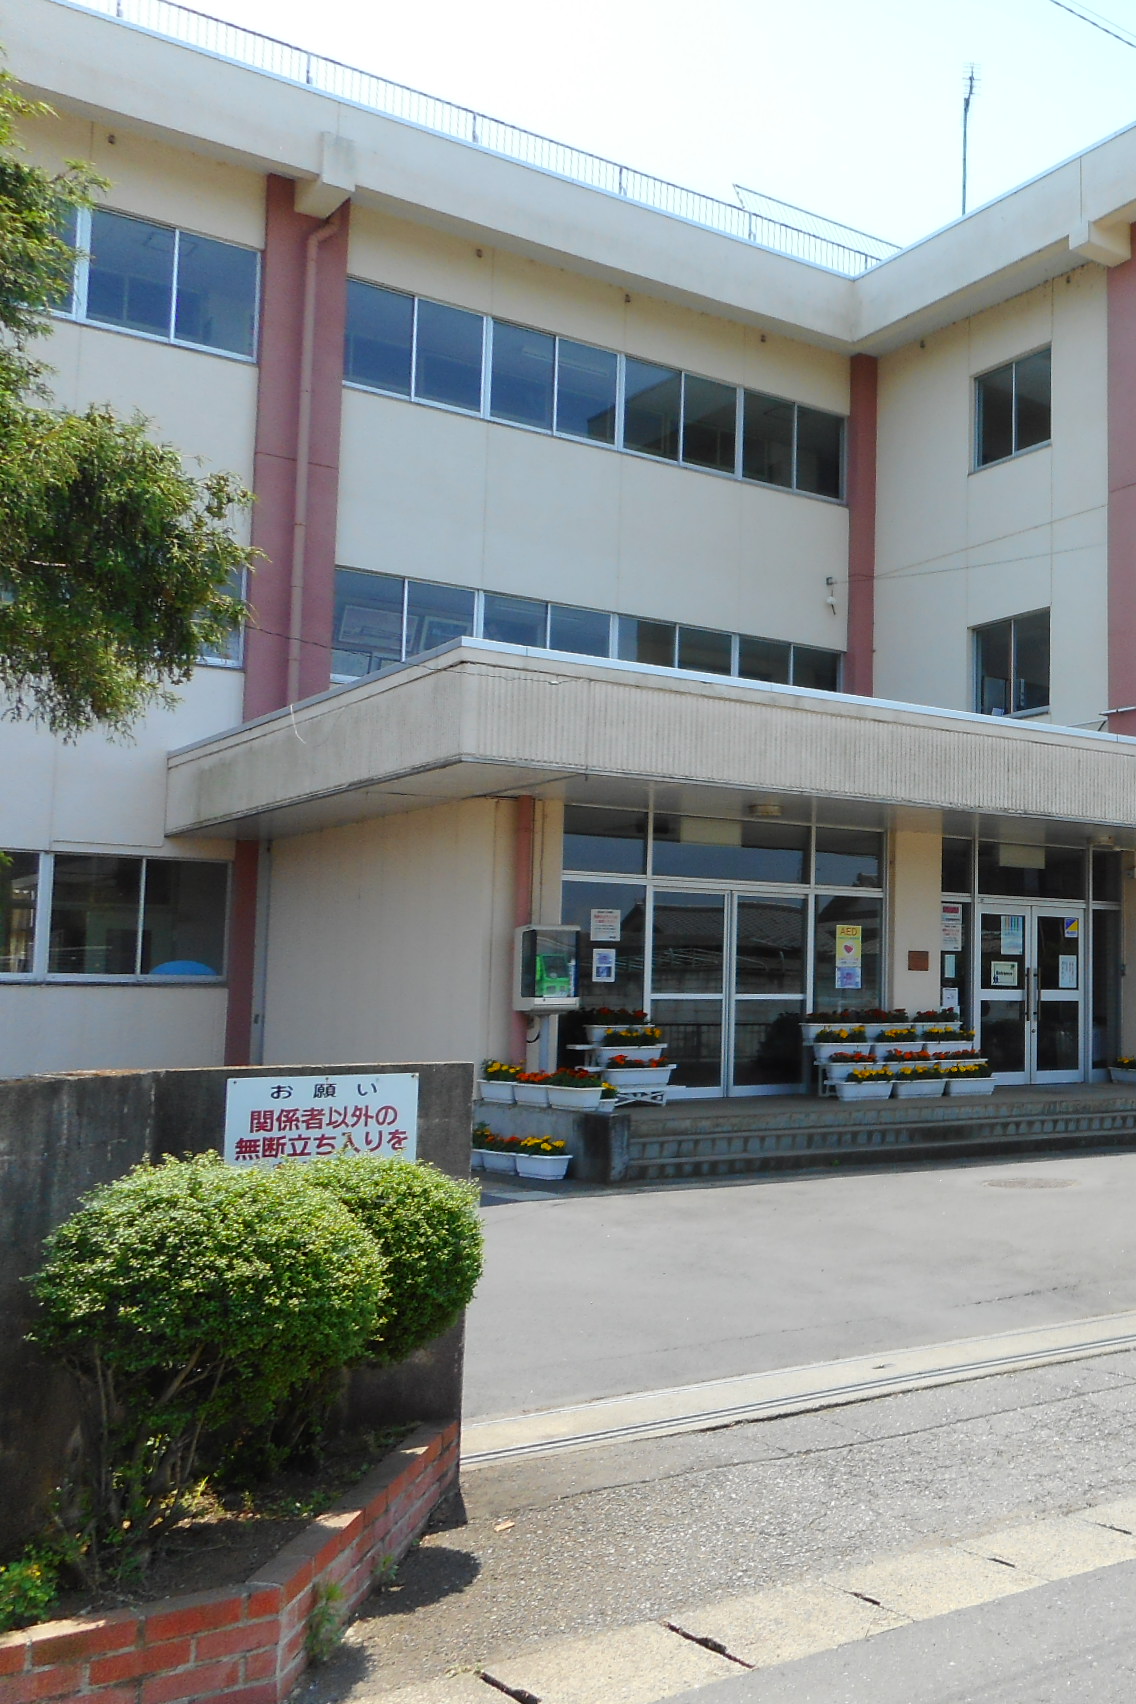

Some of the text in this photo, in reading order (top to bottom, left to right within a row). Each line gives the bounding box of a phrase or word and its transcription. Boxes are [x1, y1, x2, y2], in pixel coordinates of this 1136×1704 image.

[840, 927, 857, 936] AED
[271, 1083, 377, 1099] お願い
[250, 1105, 398, 1133] 関係者以外の
